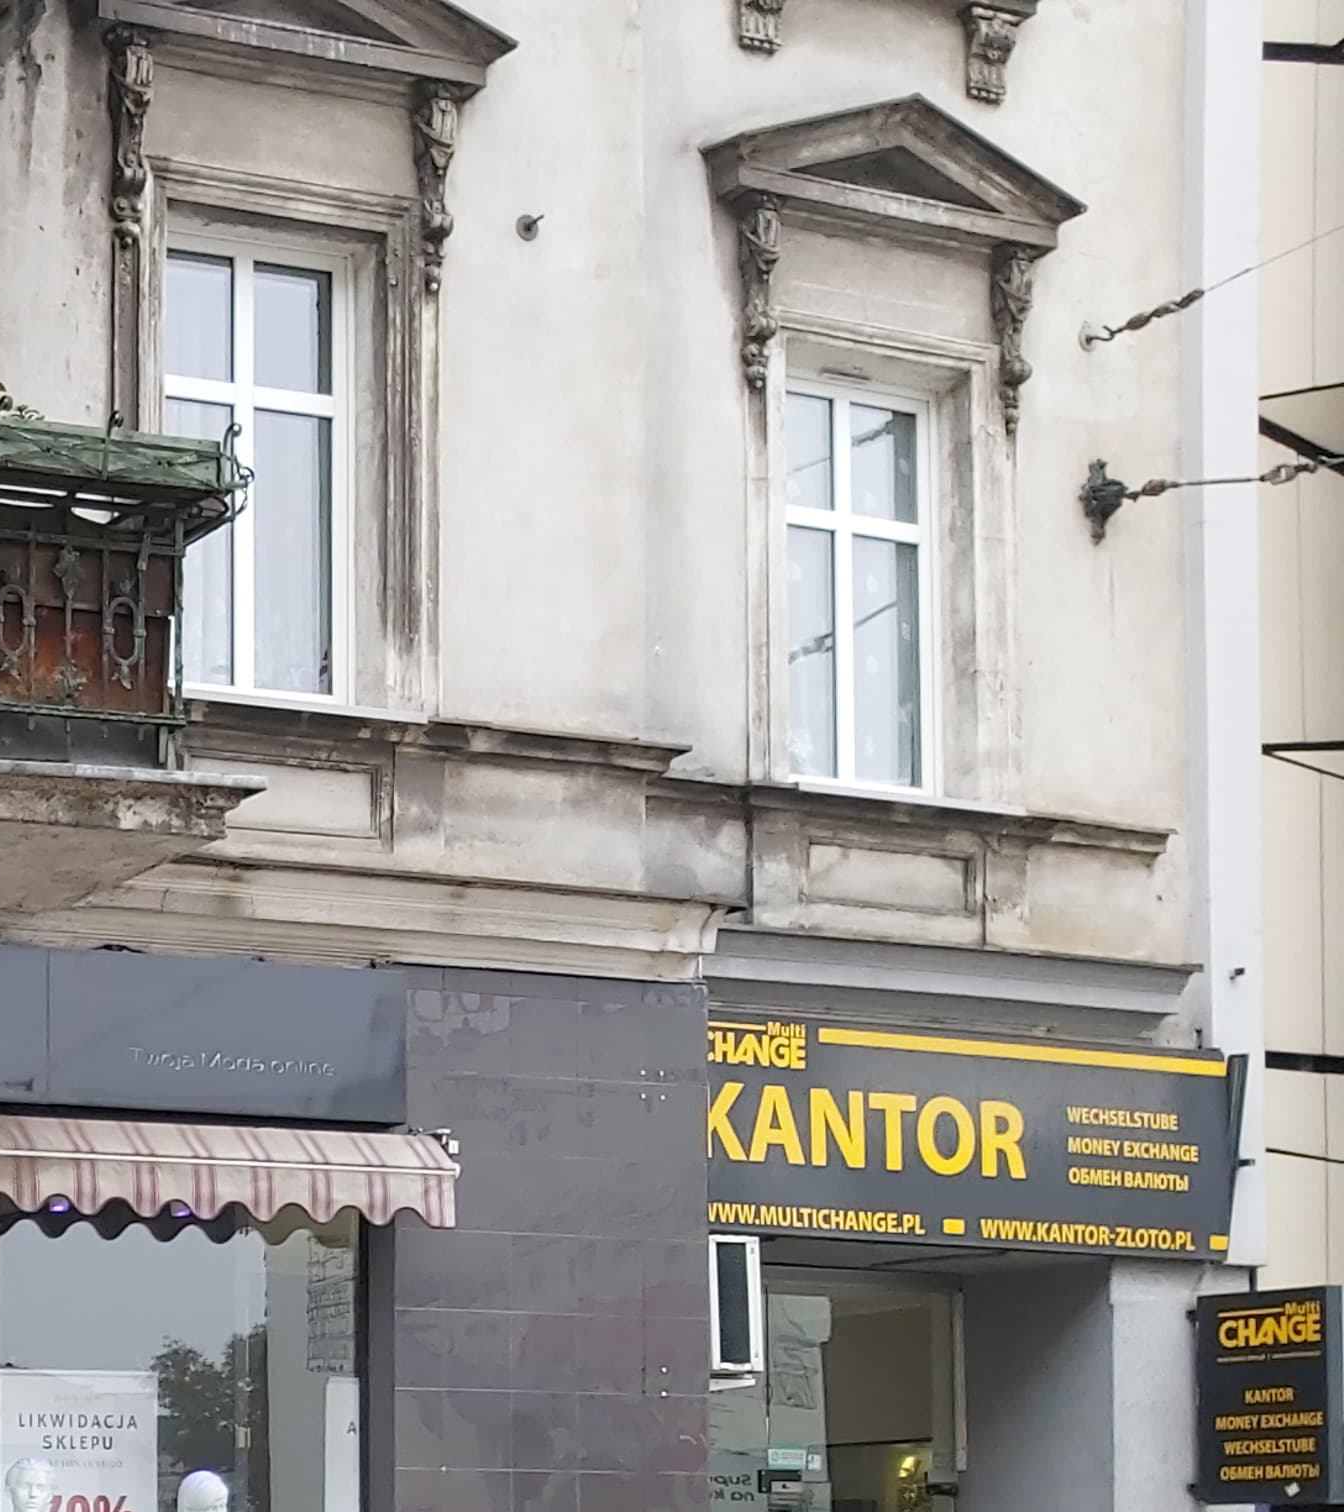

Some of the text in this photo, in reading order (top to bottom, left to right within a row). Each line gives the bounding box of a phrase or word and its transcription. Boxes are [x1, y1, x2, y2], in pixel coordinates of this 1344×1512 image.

[766, 1022, 806, 1039] Multi
[201, 1052, 265, 1073] Moda
[270, 1058, 336, 1078] online
[1067, 1106, 1179, 1131] WECHSELSTUBE
[708, 1081, 1027, 1180] KANTOR
[1067, 1136, 1199, 1163] MONEY EXCHANGE
[1068, 1167, 1189, 1192] ОБМЕН ВАЛЮТЫ
[981, 1218, 1196, 1252] WWW.KANTOR-ZLOTO.PL
[1284, 1301, 1321, 1315] Multi
[1218, 1313, 1321, 1348] CHANGE
[1244, 1387, 1294, 1404] KANTOR
[18, 1412, 138, 1430] LIKWIDACJA
[1215, 1411, 1324, 1431] MONEY EXCHANGE
[42, 1434, 114, 1450] SKLEPU
[1223, 1437, 1316, 1456] WECHSELSTUBE
[1220, 1463, 1320, 1481] ОБМЕН ВАЛЮТЫ
